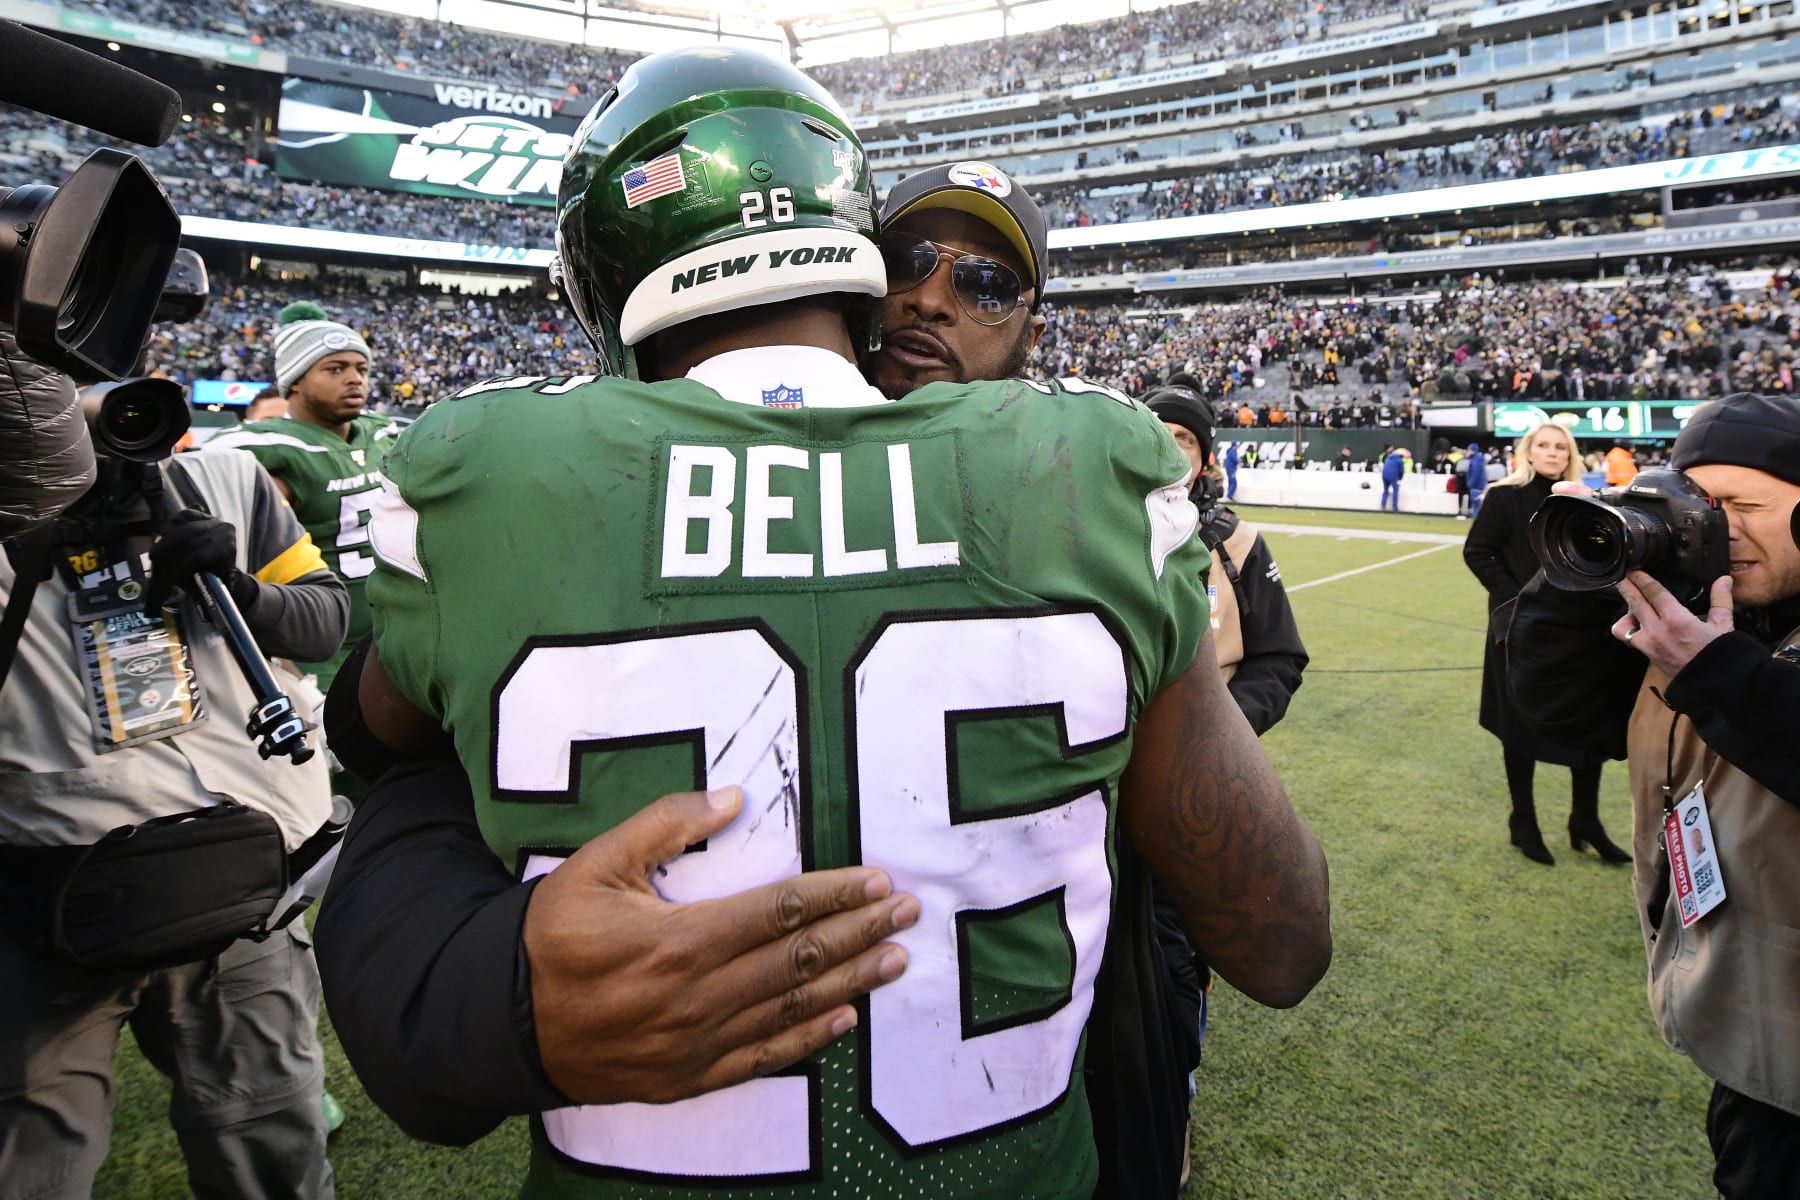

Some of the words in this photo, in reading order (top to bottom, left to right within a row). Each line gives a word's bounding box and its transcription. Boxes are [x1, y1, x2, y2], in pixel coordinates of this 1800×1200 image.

[434, 83, 552, 118] verizon
[411, 119, 573, 156] JETS
[1663, 144, 1800, 178] JETS
[738, 186, 796, 229] 26
[670, 252, 760, 294] NEW
[768, 246, 859, 269] YORK
[1586, 406, 1625, 432] 16
[325, 473, 365, 492] NEW
[1631, 485, 1657, 493] Canon
[661, 443, 960, 577] BELL
[1669, 821, 1680, 854] FIELD
[1675, 854, 1689, 894] PHOTO
[490, 601, 1132, 1182] 26
